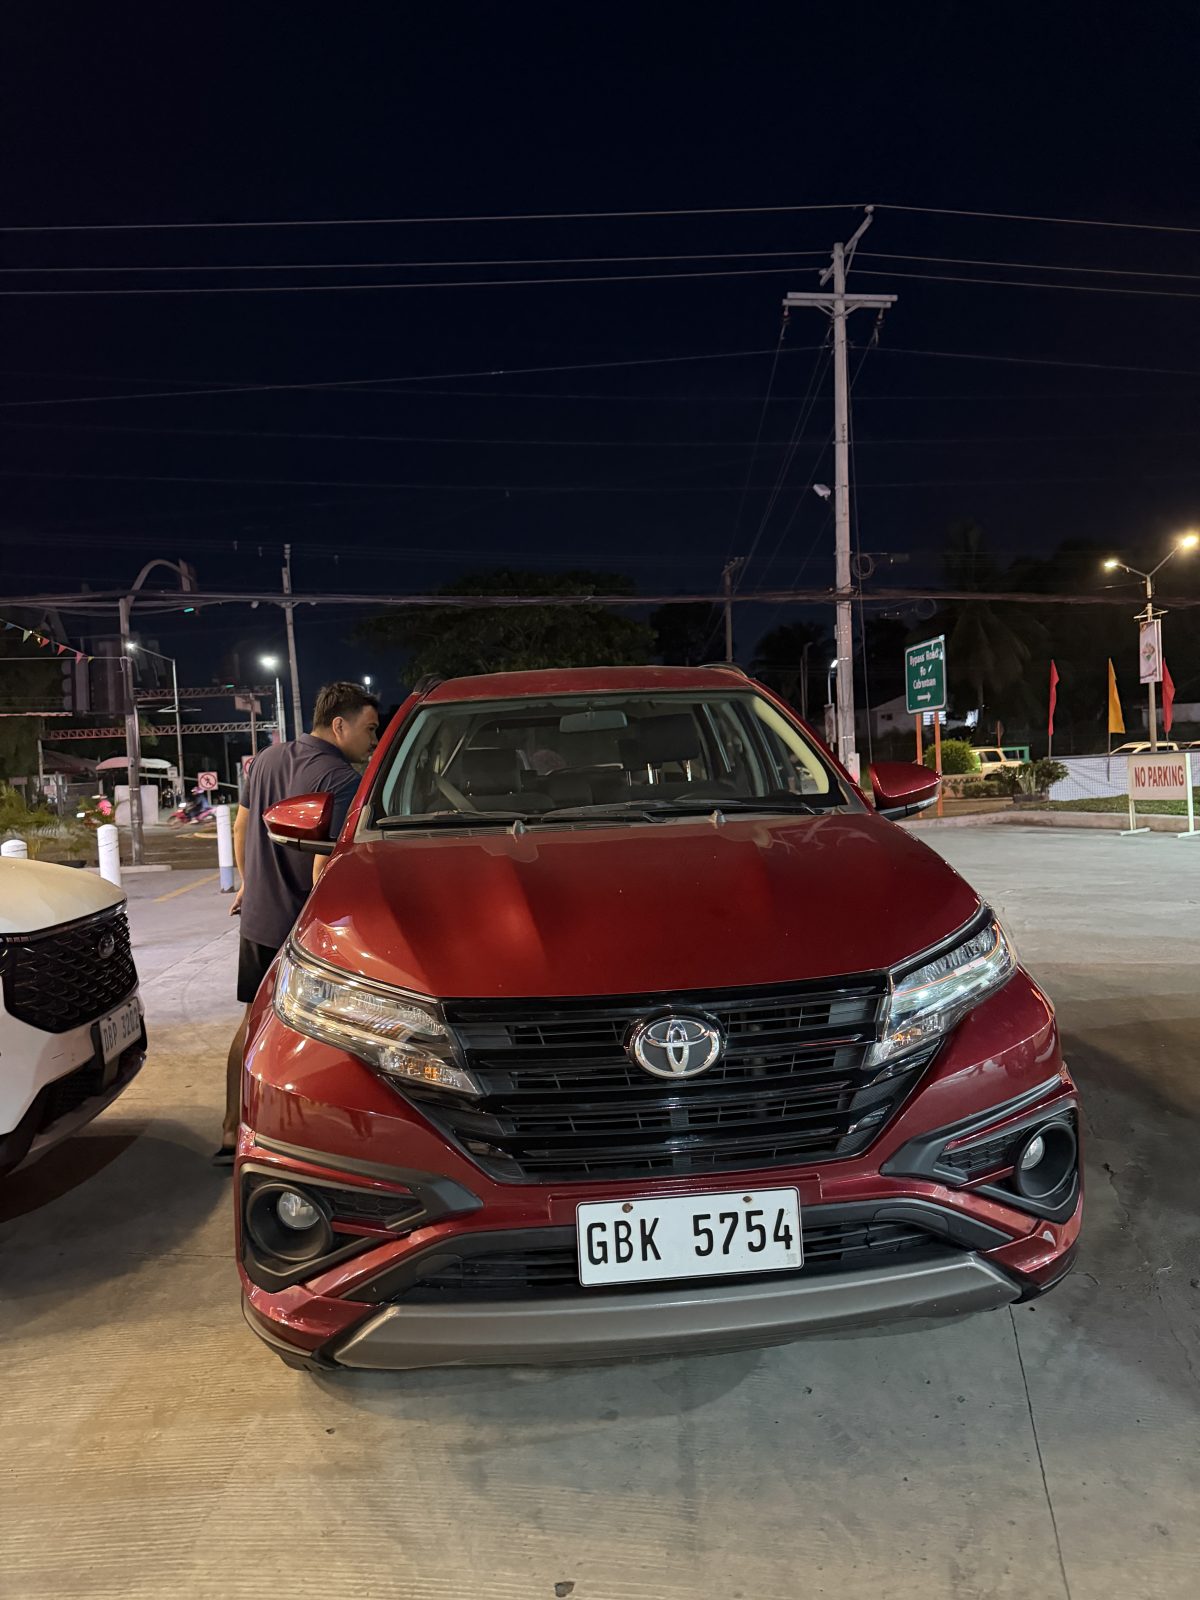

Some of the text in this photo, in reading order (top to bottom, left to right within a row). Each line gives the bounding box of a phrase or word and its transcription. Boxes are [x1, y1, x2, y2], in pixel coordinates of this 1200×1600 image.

[909, 648, 938, 666] Bypass Road
[1134, 765, 1184, 787] NO PARKING
[586, 1208, 793, 1266] GBK 5754
